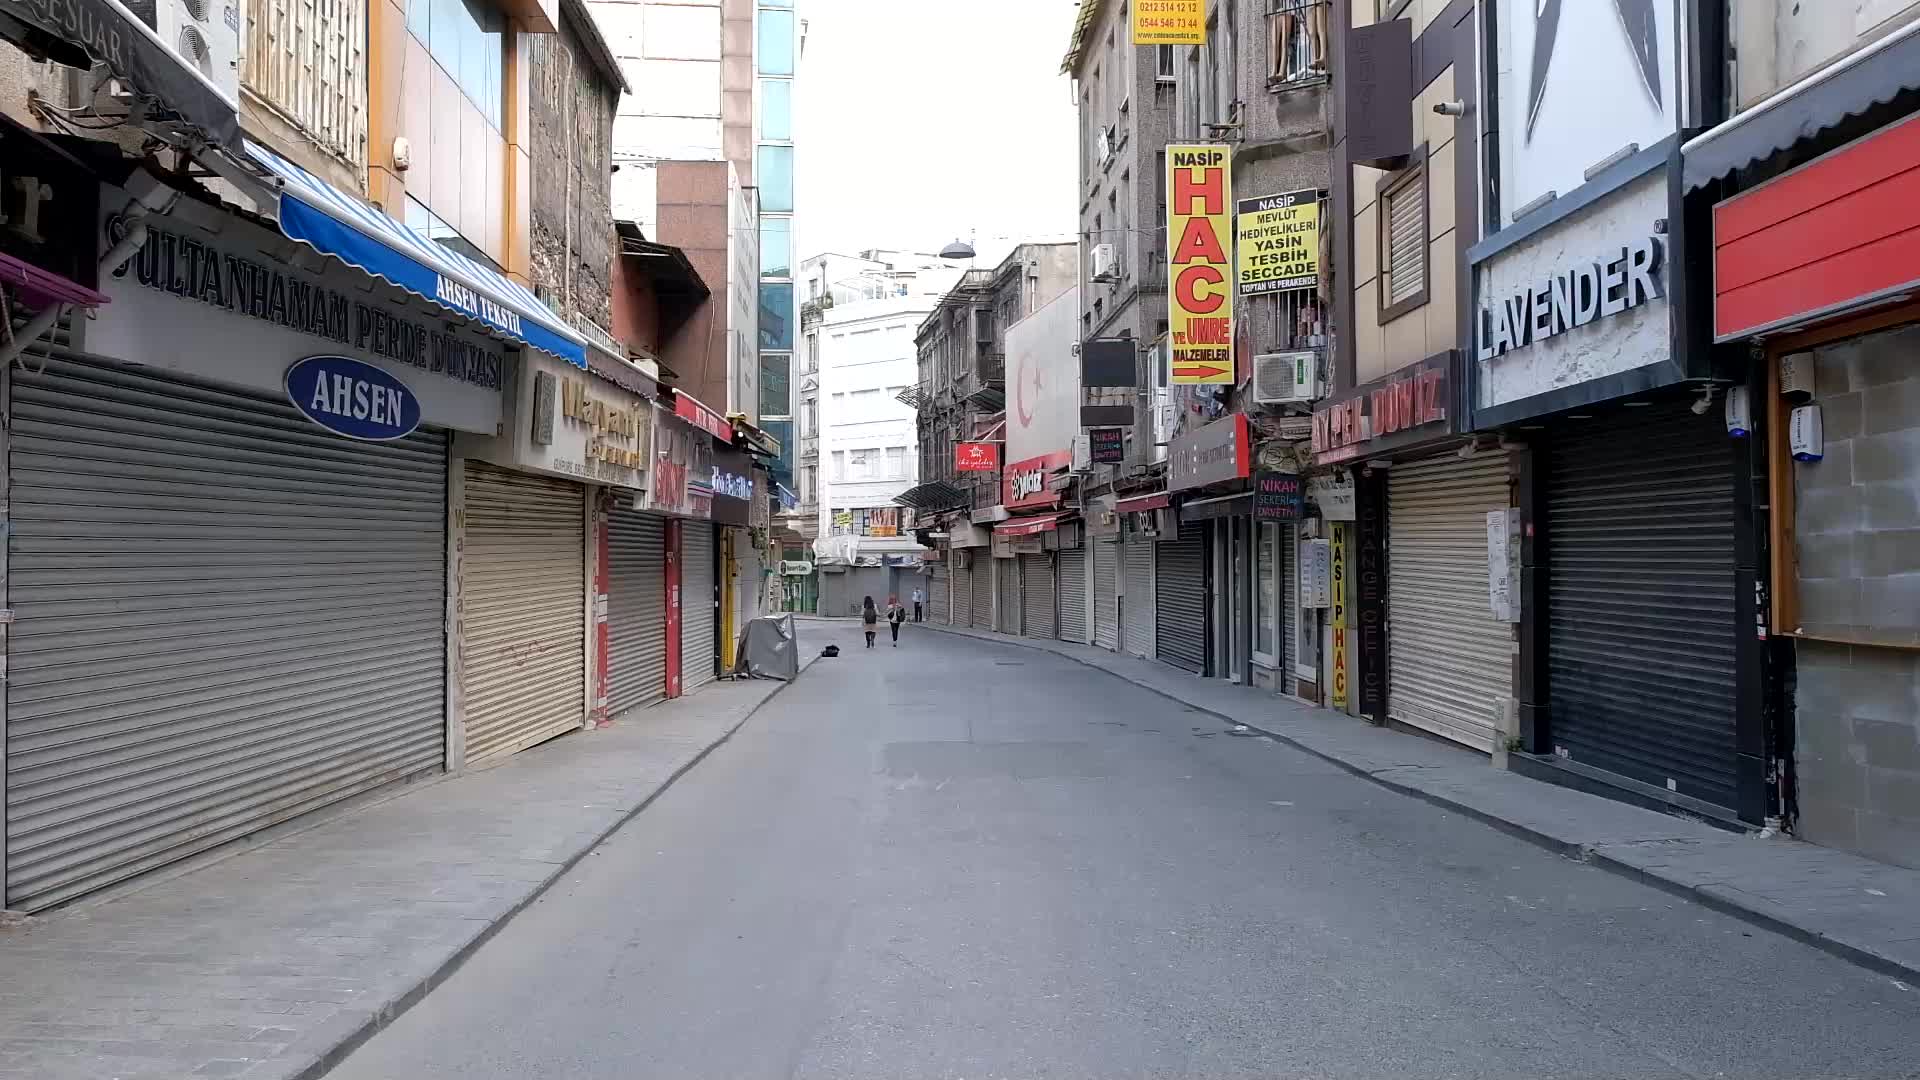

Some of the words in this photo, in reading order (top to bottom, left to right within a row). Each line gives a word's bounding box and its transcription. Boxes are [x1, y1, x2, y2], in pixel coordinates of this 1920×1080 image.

[1174, 150, 1223, 167] NASİP
[1259, 194, 1295, 210] NASİP
[1240, 218, 1316, 240] HEDİYELİKLERİ
[1172, 167, 1228, 314] HAC
[1255, 235, 1302, 251] YASİN
[1249, 248, 1308, 266] TESBİH
[1241, 261, 1316, 281] SECCADE
[436, 273, 479, 316] AHSEN
[1242, 280, 1267, 293] TOPTAN
[1268, 280, 1277, 289] VE
[1477, 236, 1665, 362] LAVENDER
[354, 302, 428, 369] PERDE
[1173, 331, 1187, 345] VE
[1187, 317, 1230, 345] UMRE
[1173, 346, 1230, 362] MALZEMELERİ
[310, 369, 403, 427] AHSEN
